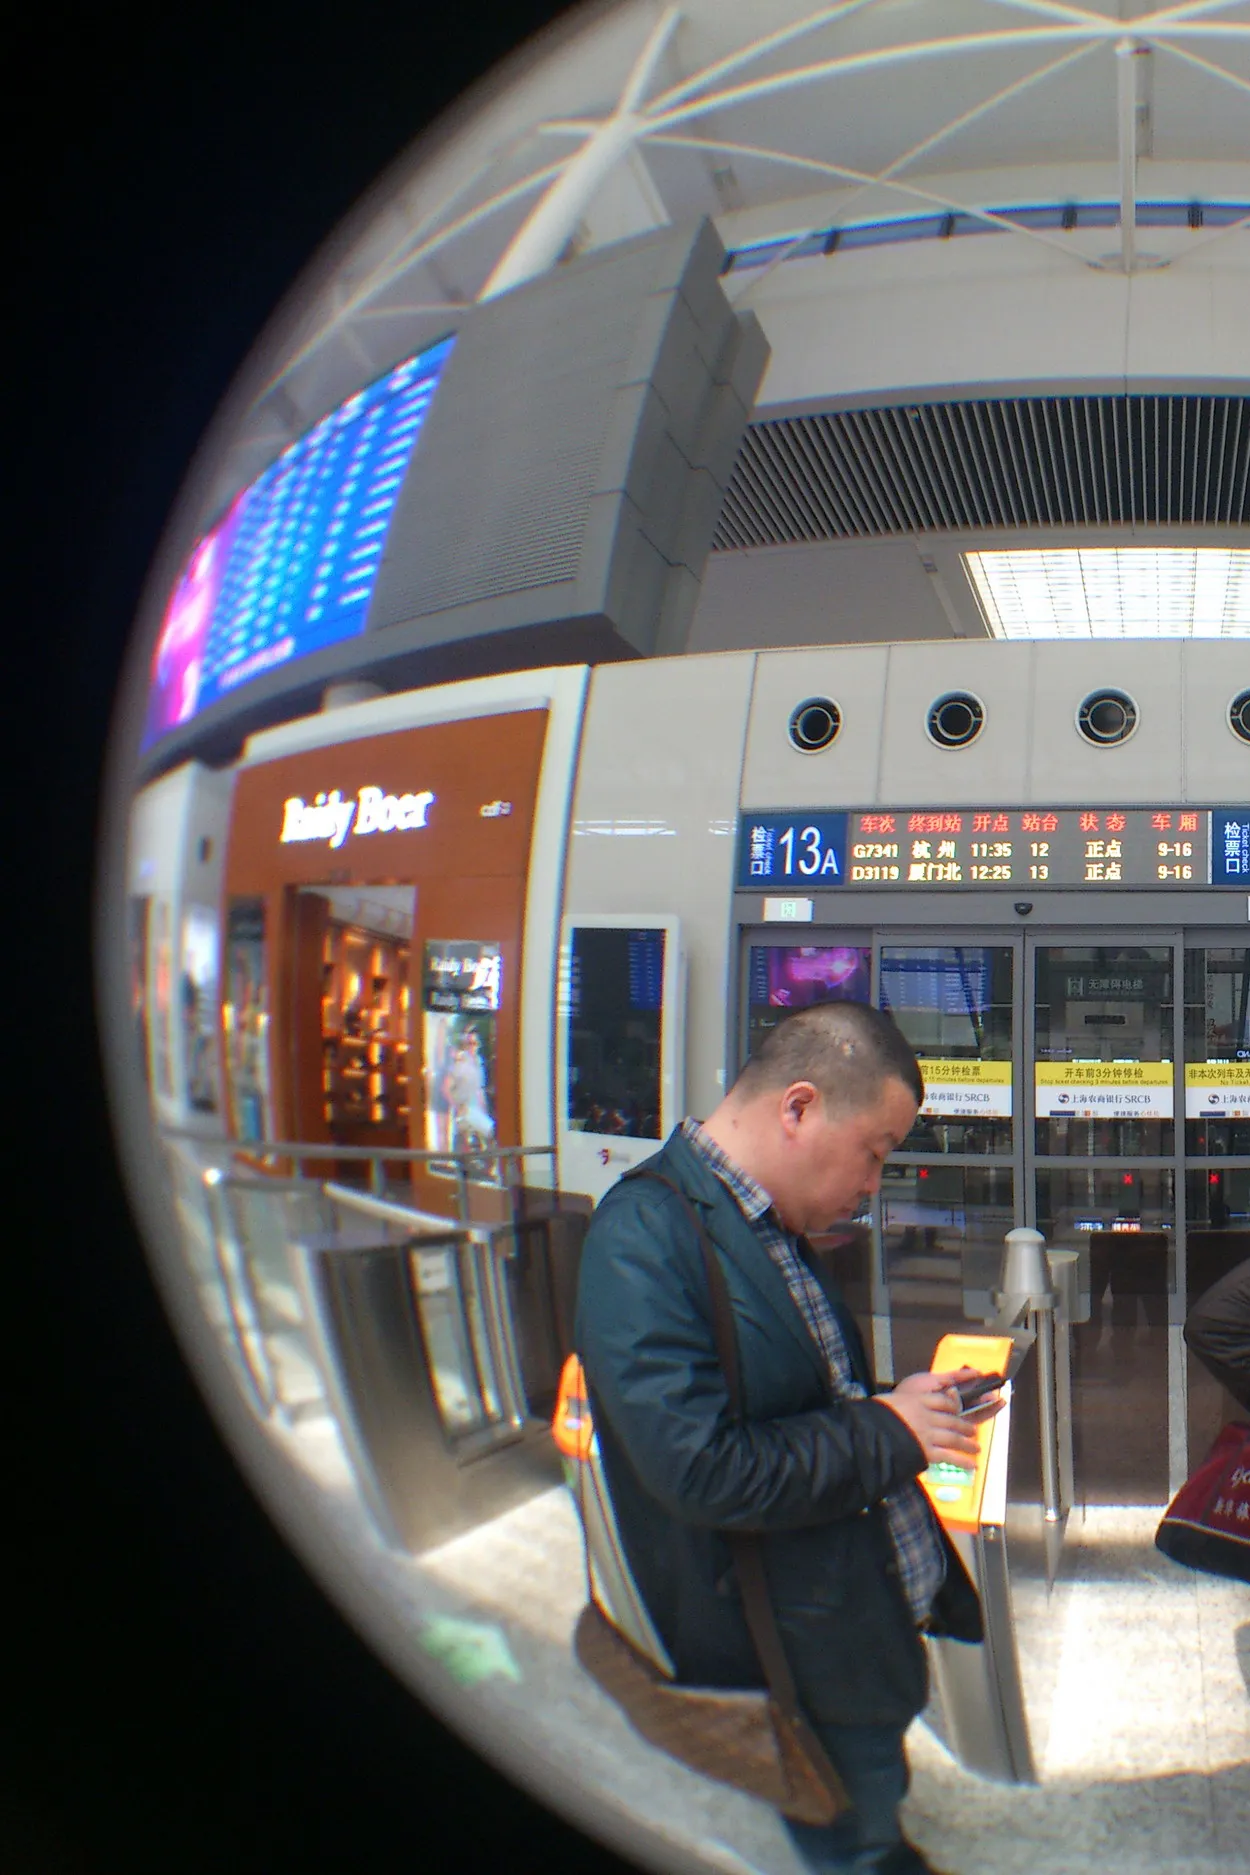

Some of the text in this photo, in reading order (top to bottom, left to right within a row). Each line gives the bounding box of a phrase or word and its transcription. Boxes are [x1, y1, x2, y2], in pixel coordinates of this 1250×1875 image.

[353, 785, 435, 834] Boer
[860, 813, 1198, 833] 车次 终到站 开点 站台 状态 车厢
[750, 826, 766, 875] 检票口
[779, 826, 839, 875] 13A
[853, 840, 1193, 859] G7341 杭州 11:35 12 正点 9-16
[1224, 821, 1241, 874] 检票口
[1242, 823, 1250, 874] Ticket check
[852, 862, 1193, 881] D3119 厦门北 12:25 13 正点 9-16
[1064, 1067, 1144, 1078] 开车前3分钟停检
[964, 1092, 990, 1102] SRCB
[1072, 1094, 1151, 1104] 上海农商银行 SRCB
